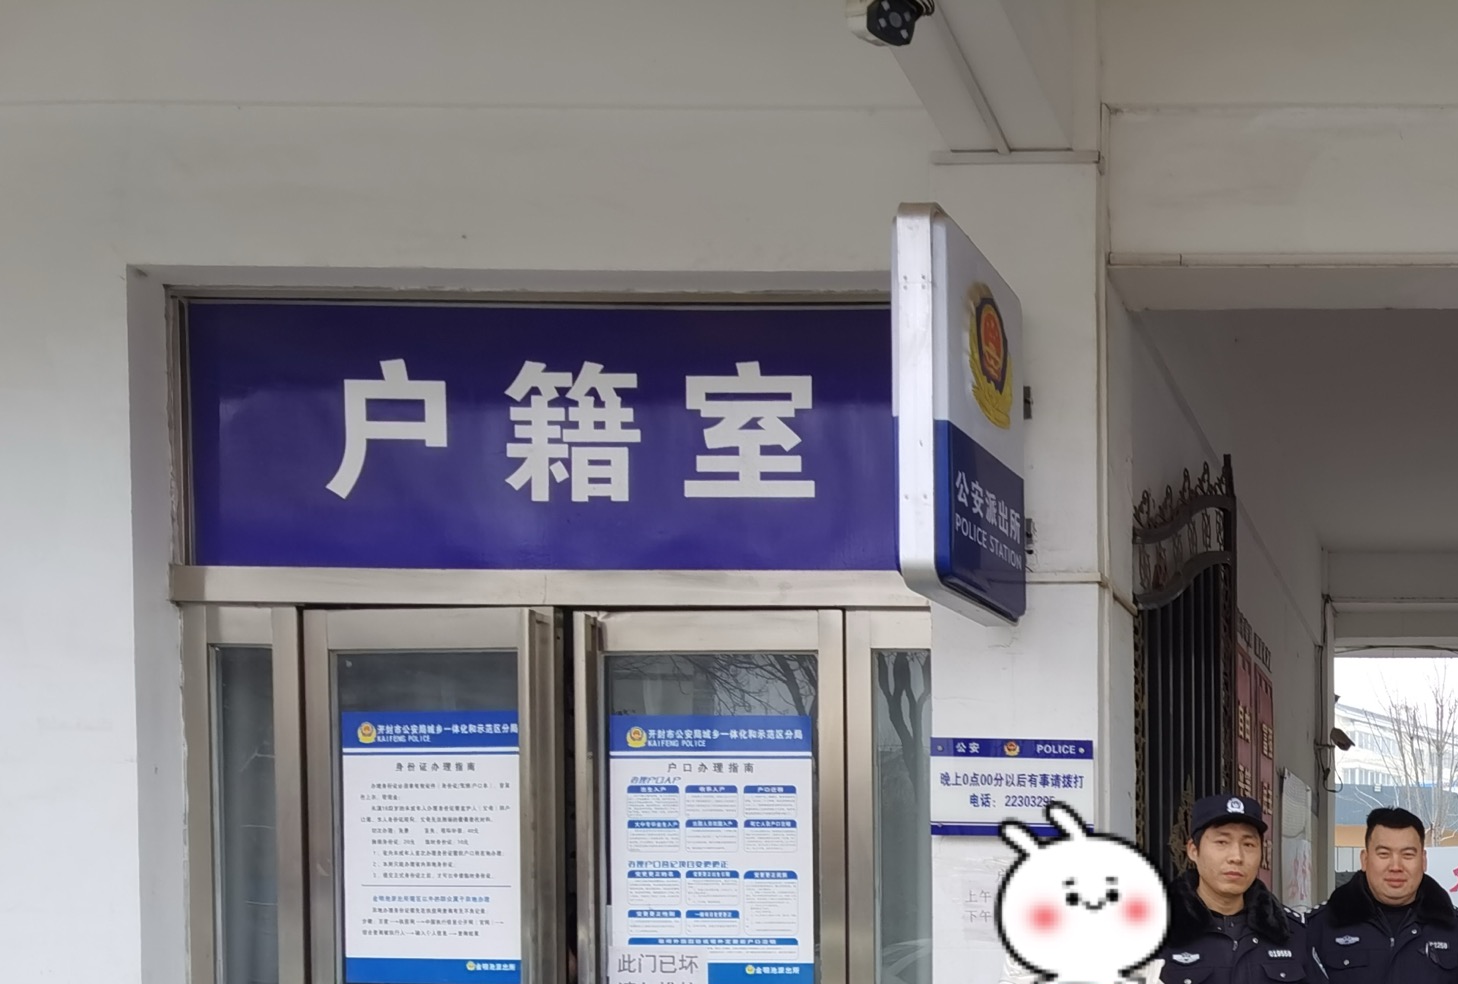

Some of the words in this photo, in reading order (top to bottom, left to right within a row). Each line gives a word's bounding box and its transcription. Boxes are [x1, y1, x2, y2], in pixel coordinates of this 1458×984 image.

[326, 358, 816, 503] 户籍室
[955, 470, 1021, 545] 公安派出所
[955, 512, 988, 549] POLICE
[989, 534, 1022, 571] STATION
[408, 735, 431, 743] POLICE
[648, 739, 679, 748] KAIFENG
[681, 739, 706, 748] POLICE
[956, 742, 980, 754] 公安
[1036, 743, 1077, 755] POLICE
[667, 762, 755, 774] 户口办理指南
[940, 771, 1084, 789] 晚上0点00分以后有事请拨打
[617, 953, 699, 974] 此门已坏
